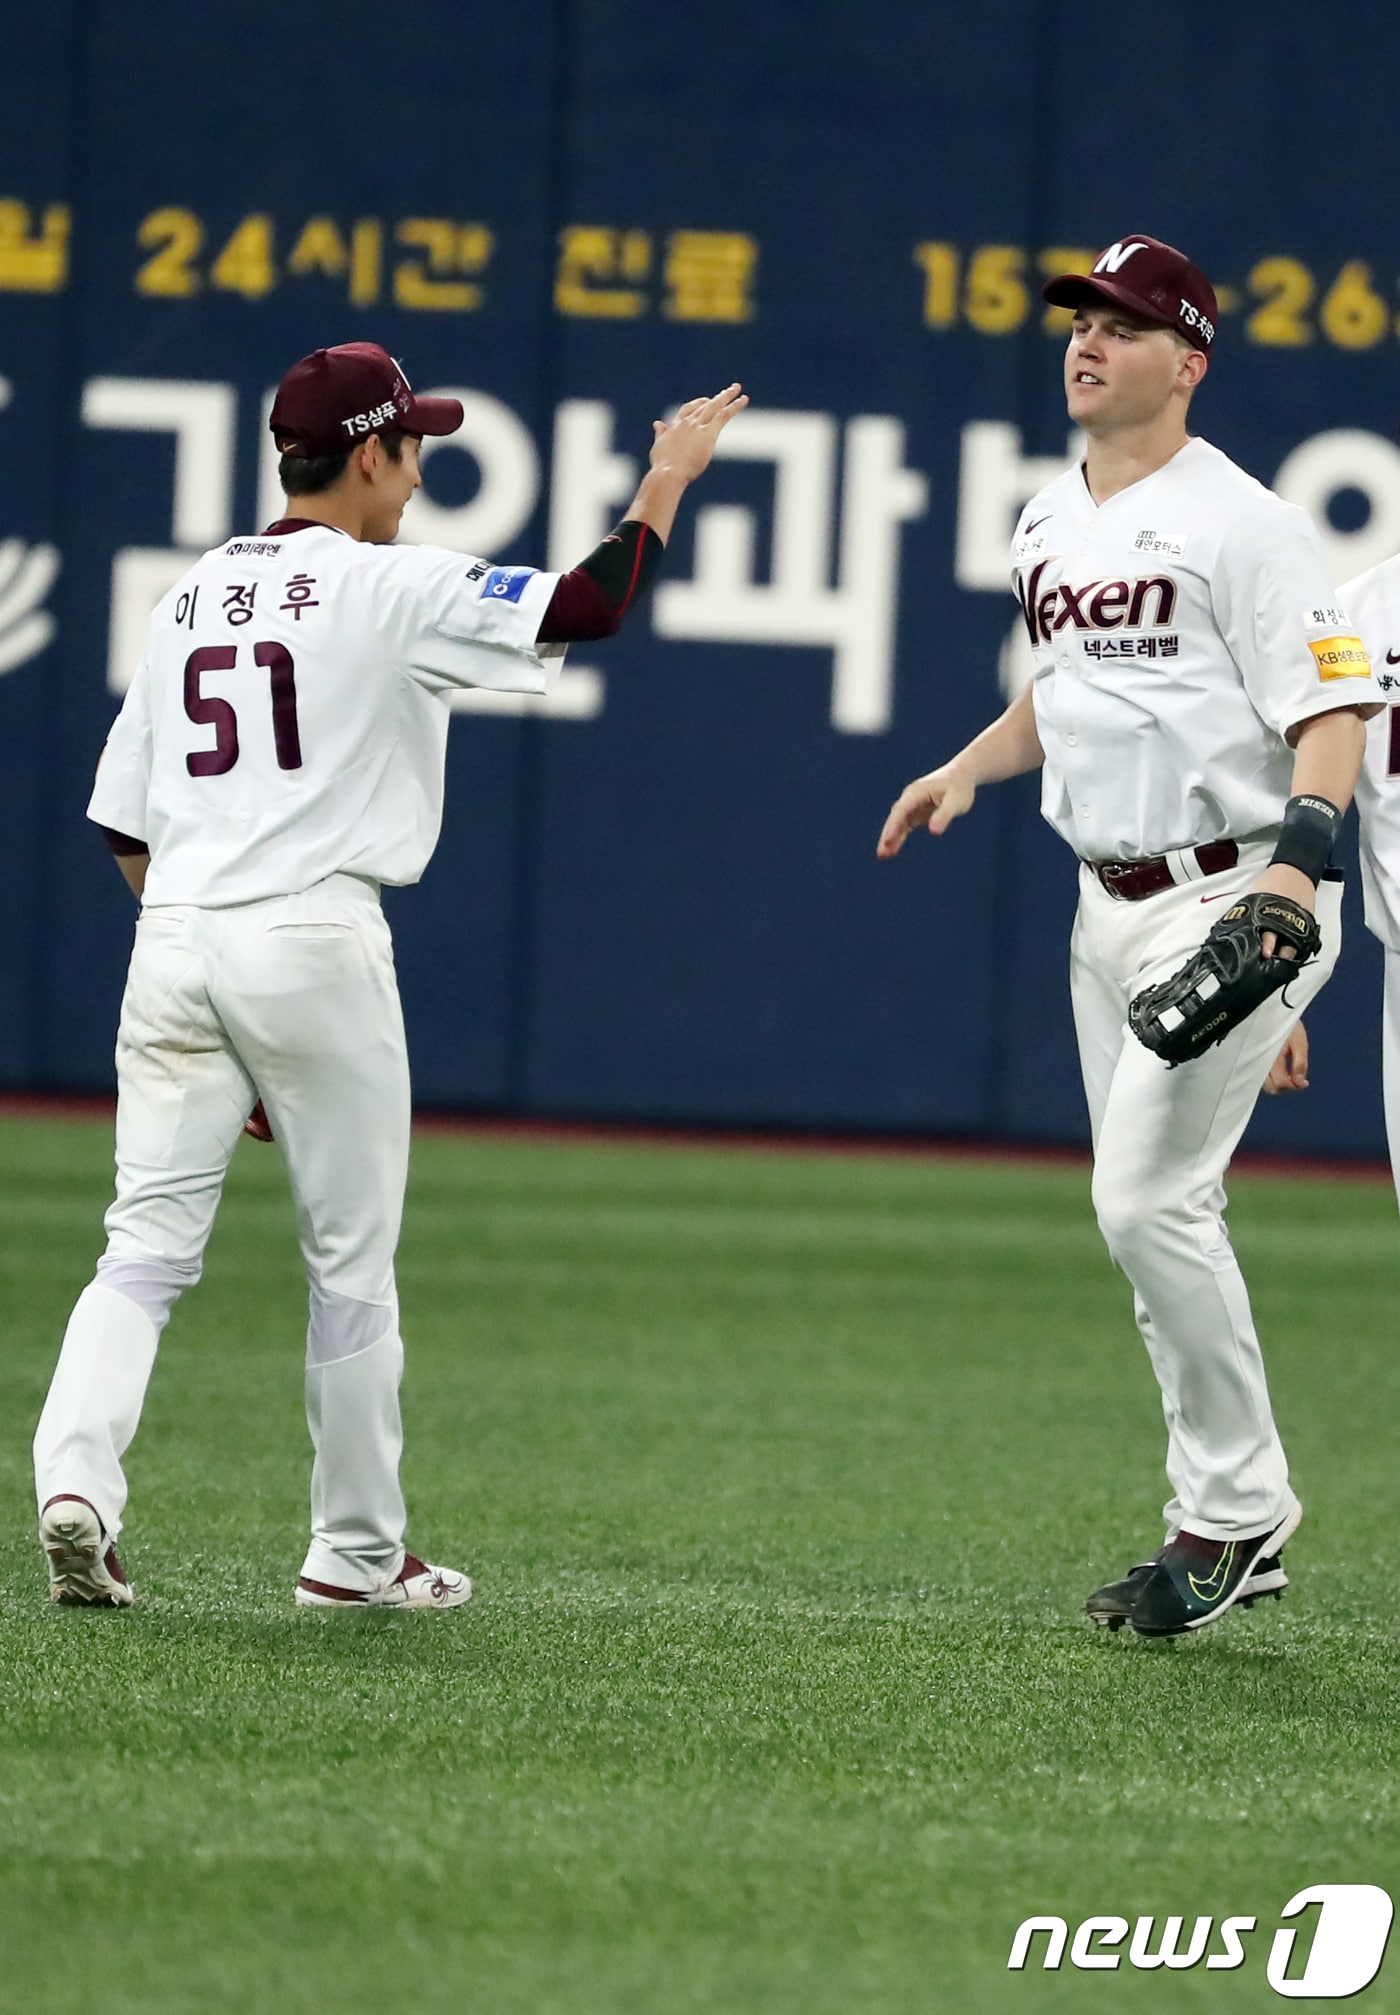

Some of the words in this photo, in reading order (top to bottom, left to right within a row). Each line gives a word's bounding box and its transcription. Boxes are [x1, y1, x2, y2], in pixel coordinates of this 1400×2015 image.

[136, 205, 491, 311] 24시간
[1093, 242, 1149, 273] N
[341, 400, 398, 436] TS샴푸
[1012, 556, 1178, 649] Nexen
[1083, 636, 1179, 660] 넥스트레벨
[183, 640, 303, 778] 51
